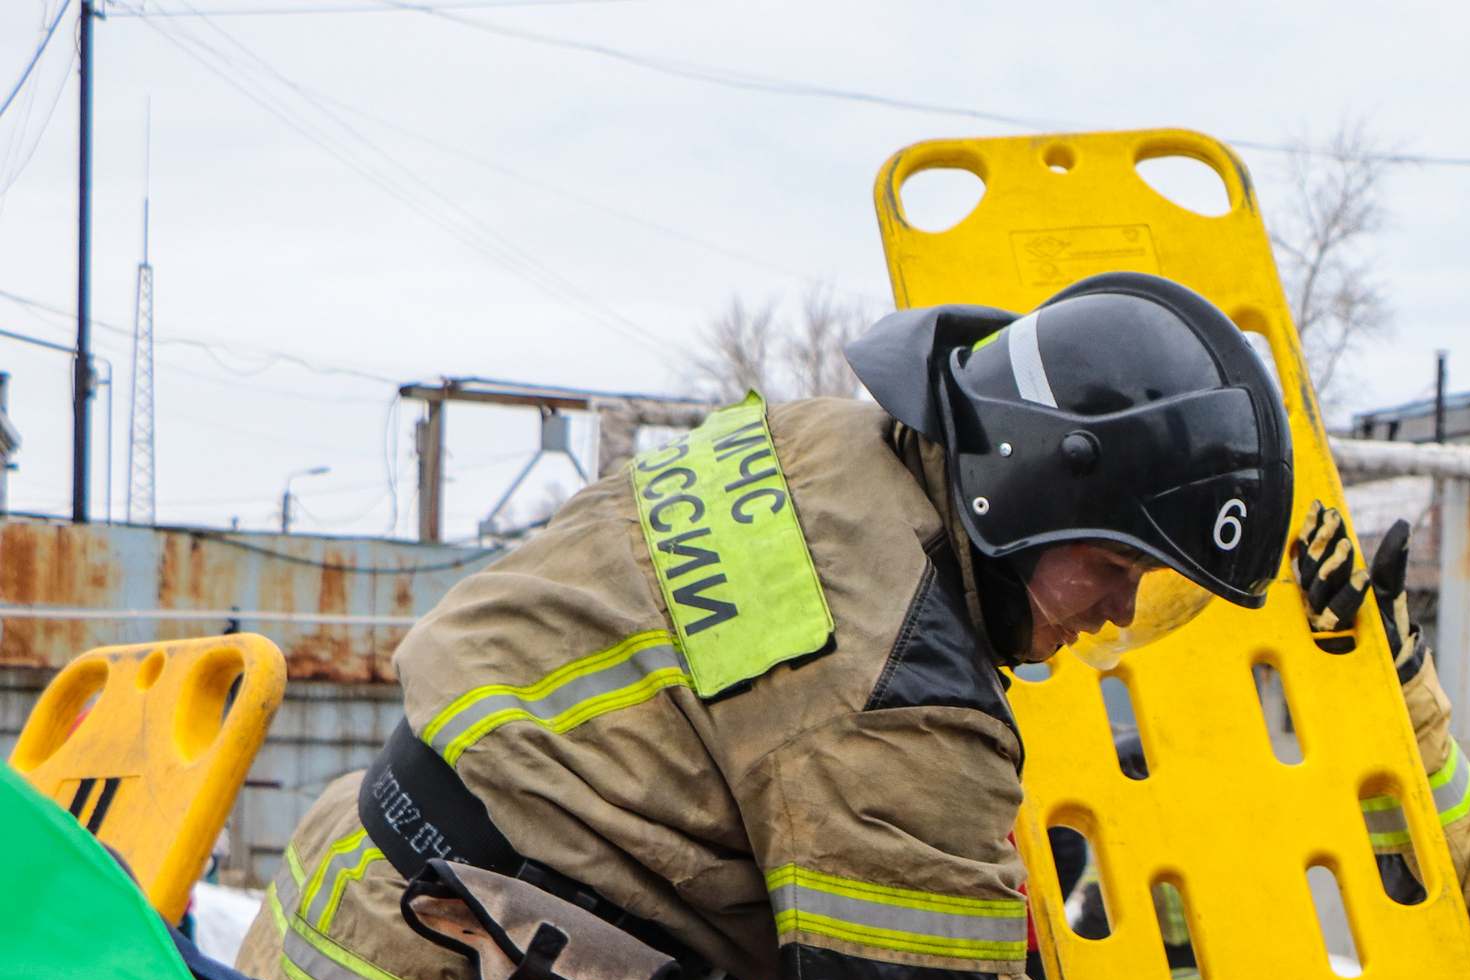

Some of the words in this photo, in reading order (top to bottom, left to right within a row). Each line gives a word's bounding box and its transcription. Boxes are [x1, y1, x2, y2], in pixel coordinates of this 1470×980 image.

[713, 420, 787, 525] МЧС
[1213, 498, 1247, 551] 6
[637, 433, 738, 637] ОССИИ
